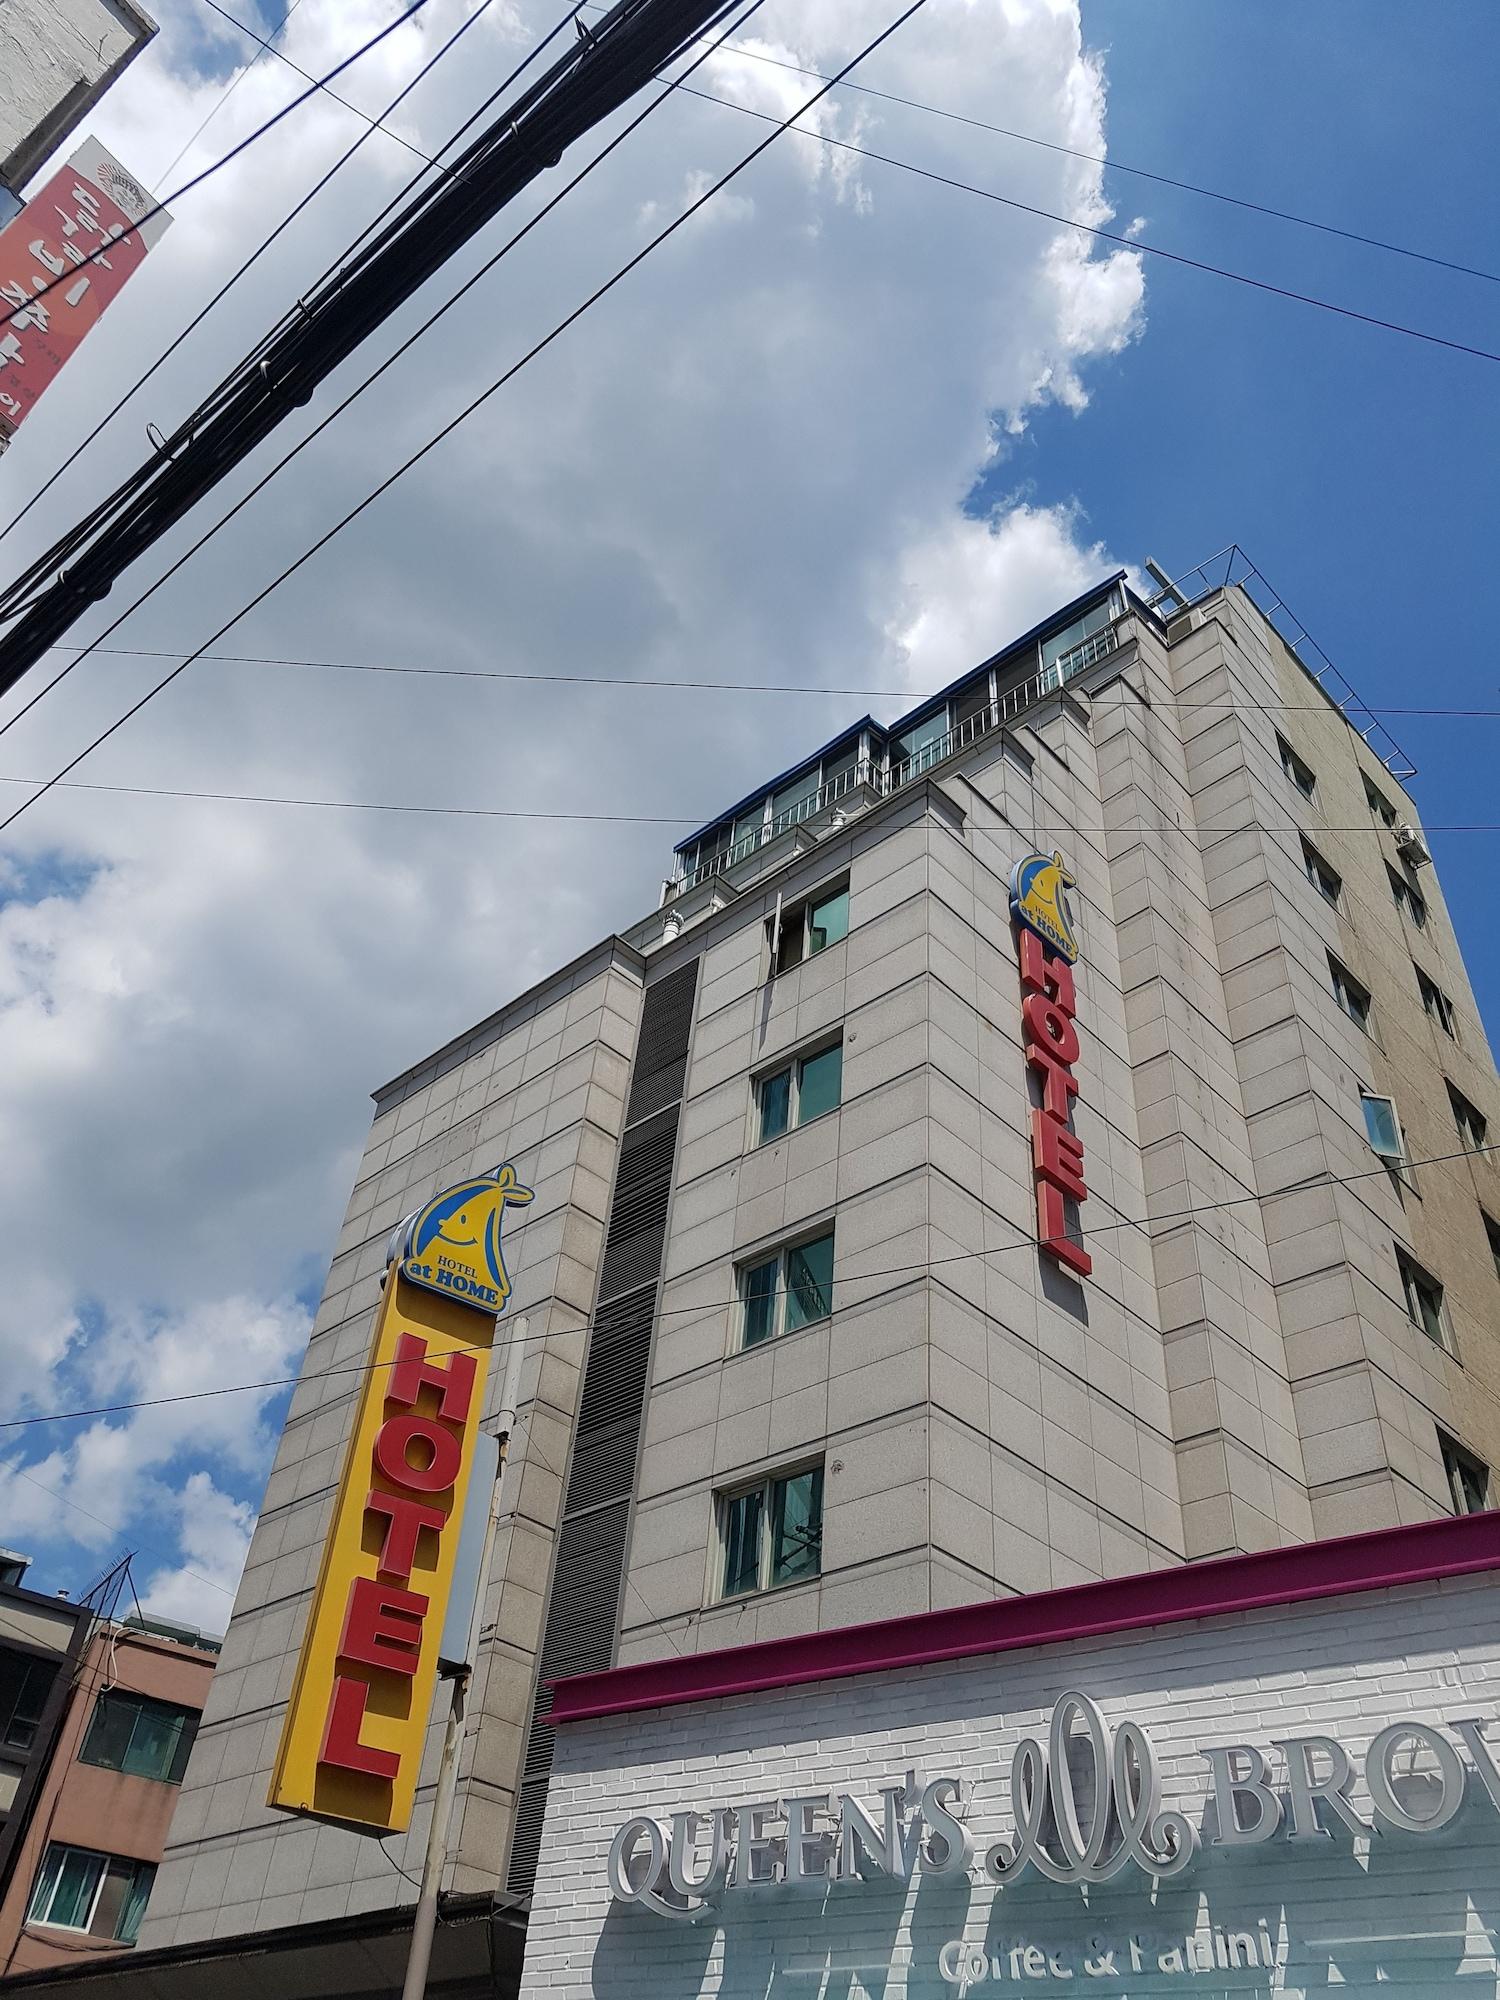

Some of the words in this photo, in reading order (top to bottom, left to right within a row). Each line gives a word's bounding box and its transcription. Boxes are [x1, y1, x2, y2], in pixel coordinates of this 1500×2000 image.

[1036, 906, 1059, 931] HOTEL
[1037, 915, 1073, 956] HOME
[1020, 928, 1092, 1276] HOTEL
[410, 1263, 432, 1279] at
[435, 1268, 498, 1305] HOME
[438, 1255, 477, 1279] HOTEL
[317, 1332, 477, 1780] HOTEL
[608, 1769, 974, 1919] QUEEN'S
